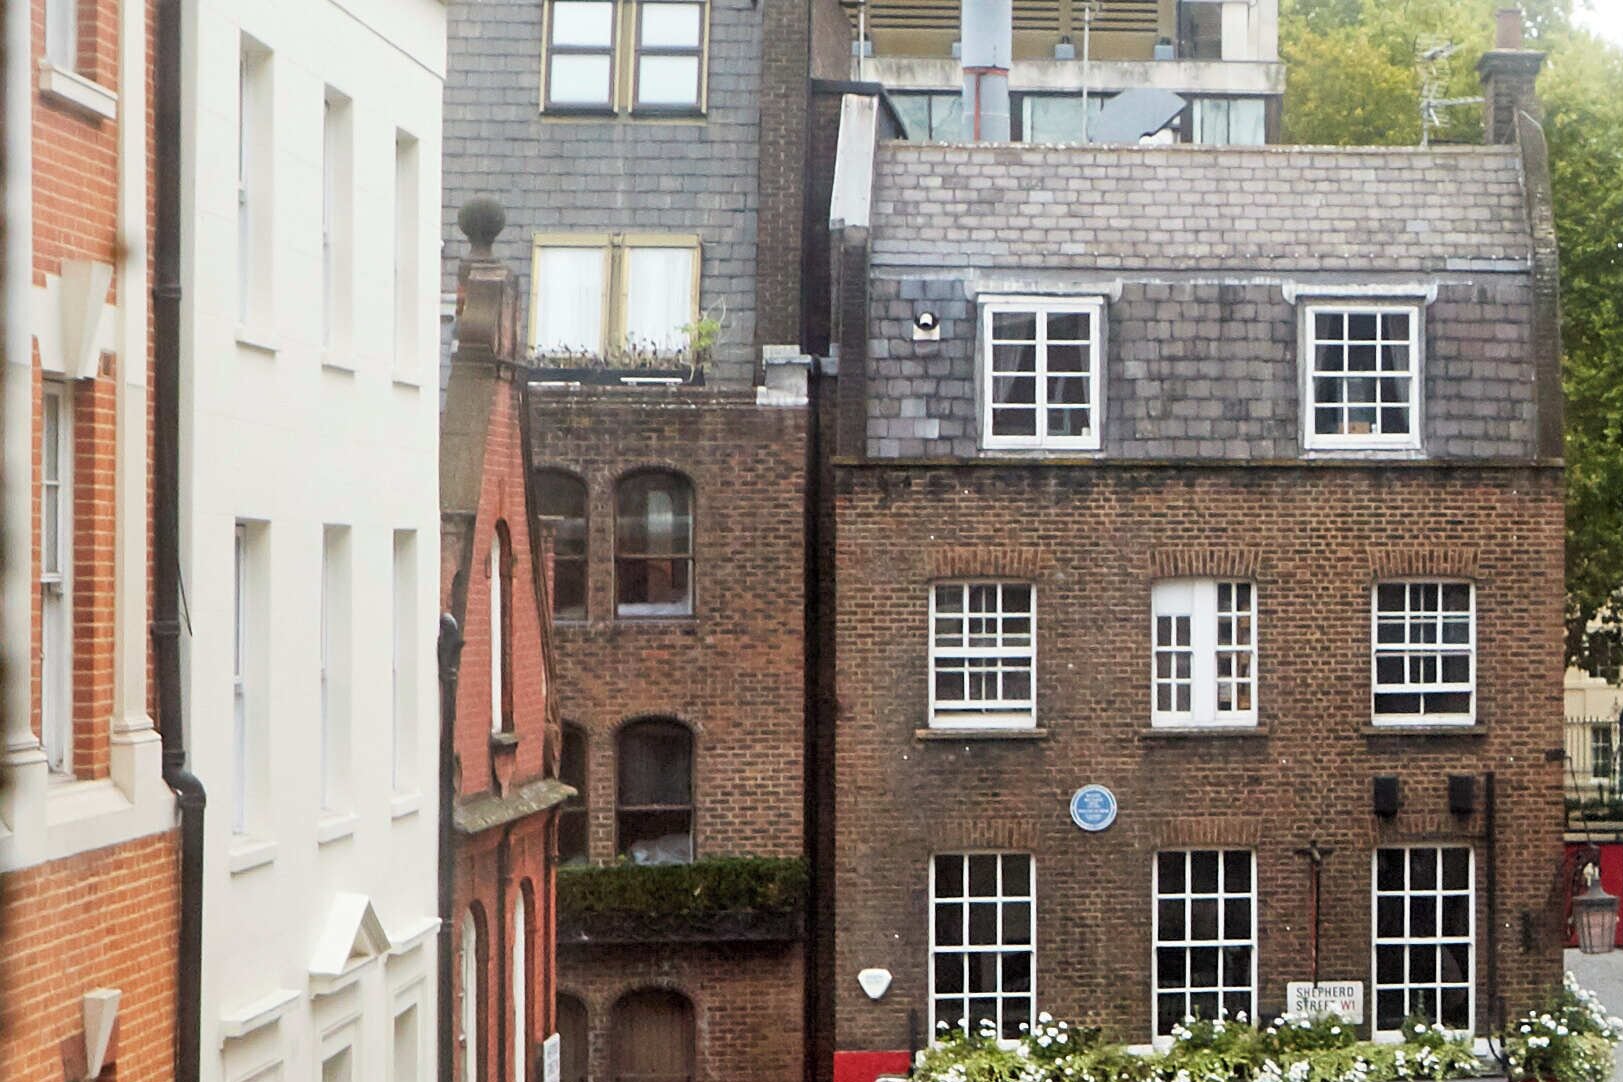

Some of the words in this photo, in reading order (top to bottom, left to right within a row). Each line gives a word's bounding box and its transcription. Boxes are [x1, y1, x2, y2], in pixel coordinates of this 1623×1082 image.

[1296, 986, 1354, 998] SHEPHERD
[1296, 1000, 1336, 1011] STREE
[1341, 1000, 1356, 1010] W1
